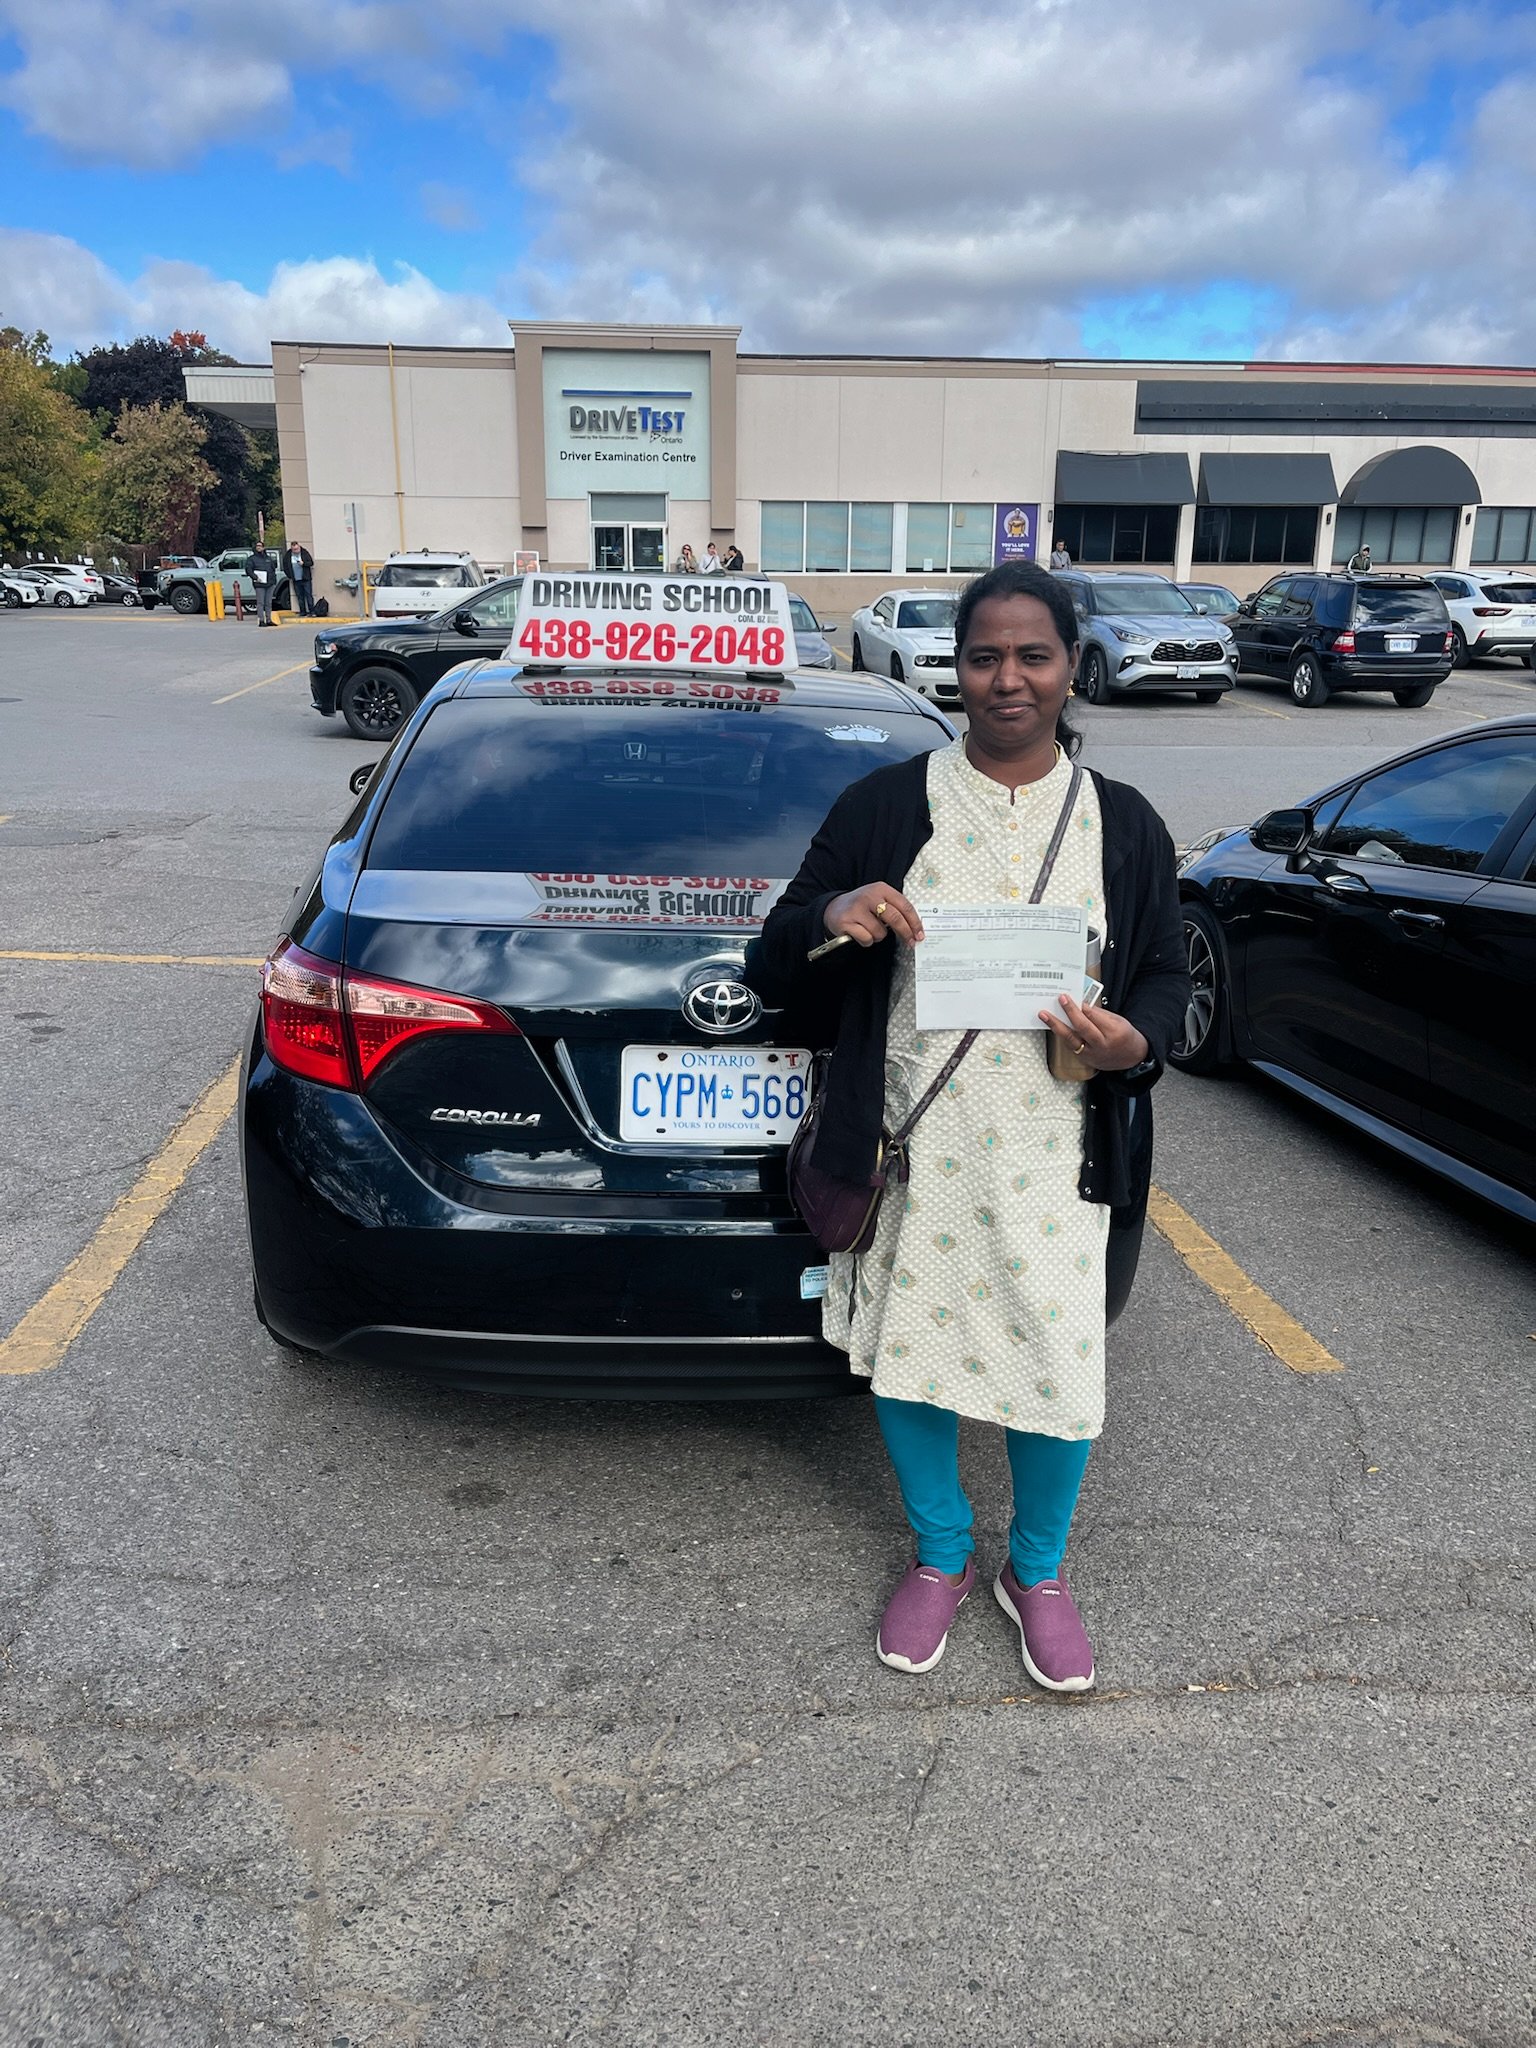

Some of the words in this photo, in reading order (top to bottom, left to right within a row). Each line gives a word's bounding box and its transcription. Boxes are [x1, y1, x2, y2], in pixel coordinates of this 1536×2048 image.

[661, 436, 683, 444] Ontario
[560, 451, 592, 461] Driver
[594, 451, 659, 463] Examination
[662, 452, 697, 463] Centre
[532, 579, 652, 612] DRIVING
[663, 584, 779, 616] SCHOOL
[519, 619, 785, 667] 438-926-2048
[681, 1052, 756, 1069] ONTARIO
[632, 1072, 720, 1119] CYPM
[742, 1074, 804, 1120] 568
[430, 1107, 541, 1127] COROLLA
[673, 1121, 701, 1129] YOURS
[704, 1121, 716, 1130] TO
[718, 1122, 761, 1130] DISCOVER
